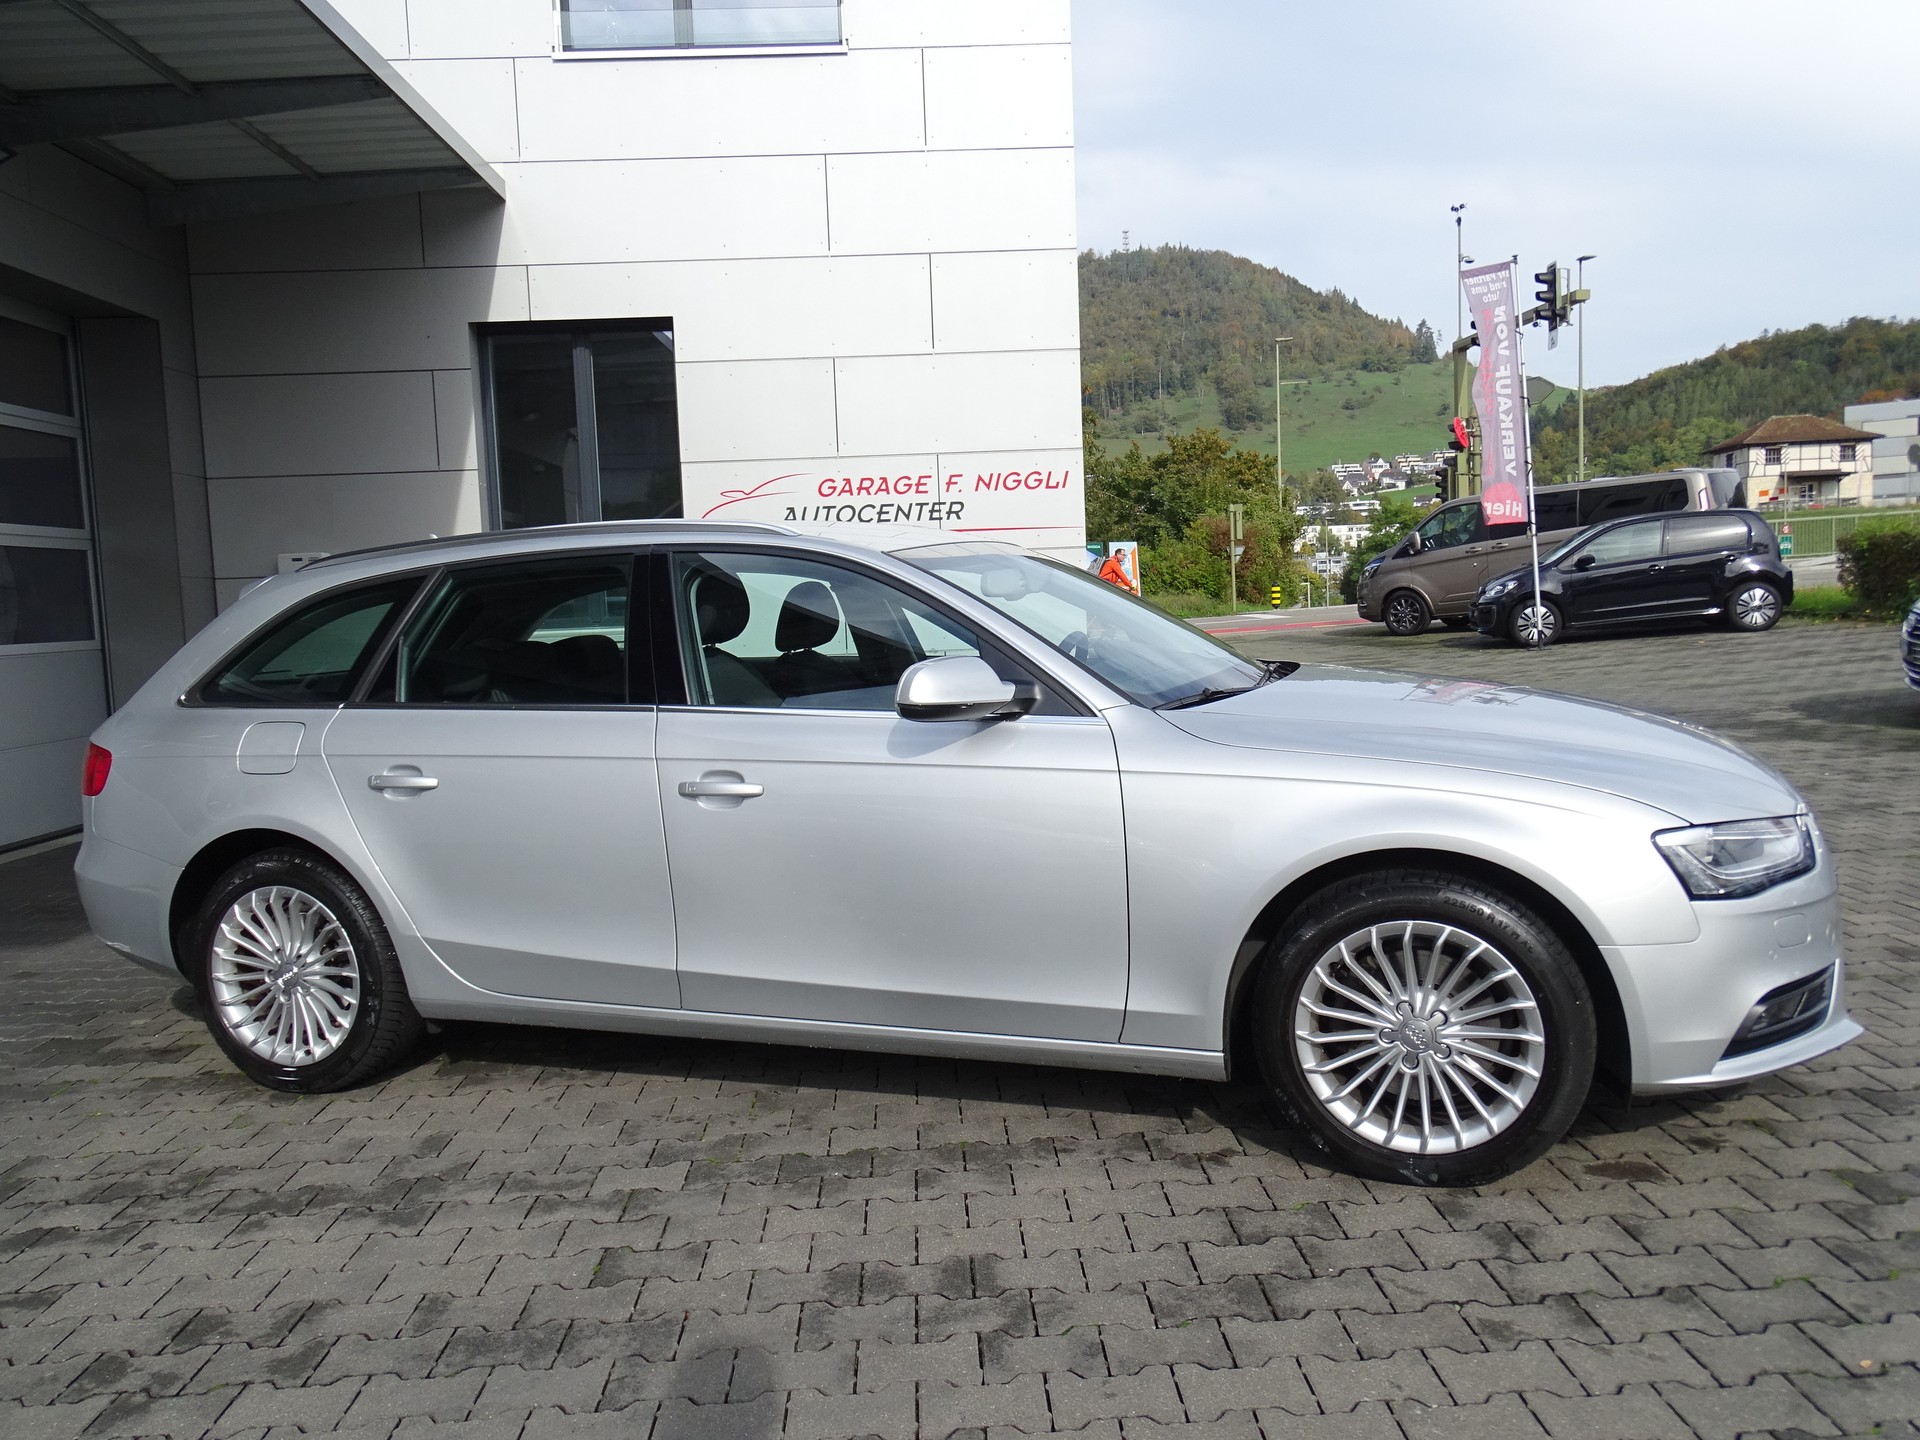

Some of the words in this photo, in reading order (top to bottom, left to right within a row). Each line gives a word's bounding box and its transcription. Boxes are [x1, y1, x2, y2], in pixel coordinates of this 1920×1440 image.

[818, 475, 933, 498] GARAGE
[945, 473, 964, 494] F.
[974, 470, 1070, 492] NIGGLI
[784, 500, 966, 523] AUTOCENTER
[1443, 895, 1485, 917] 225/50
